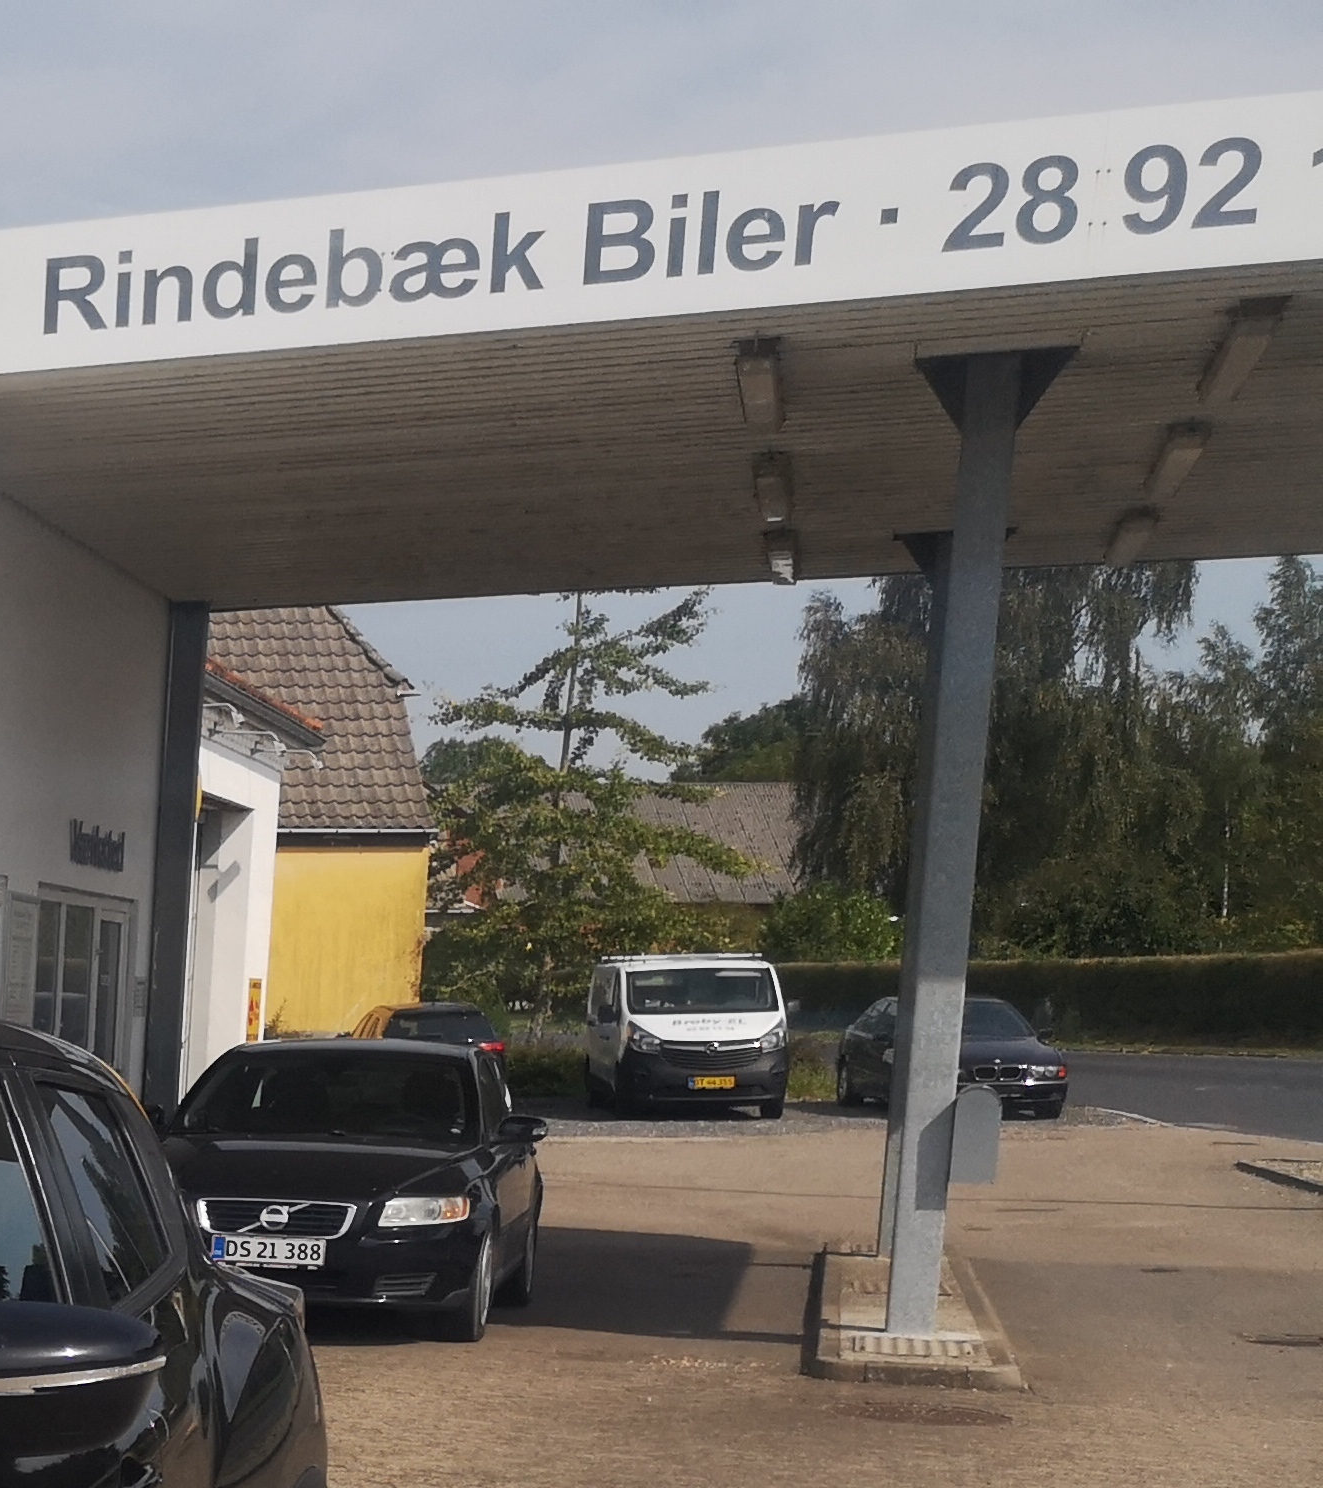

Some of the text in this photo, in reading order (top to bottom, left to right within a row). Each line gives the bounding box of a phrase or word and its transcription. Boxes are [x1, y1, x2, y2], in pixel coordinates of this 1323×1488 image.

[41, 210, 545, 335] Rindebæk
[583, 193, 841, 287] Biler
[941, 154, 1082, 253] 28
[1121, 135, 1263, 236] 92
[225, 1240, 322, 1262] DS 21 388
